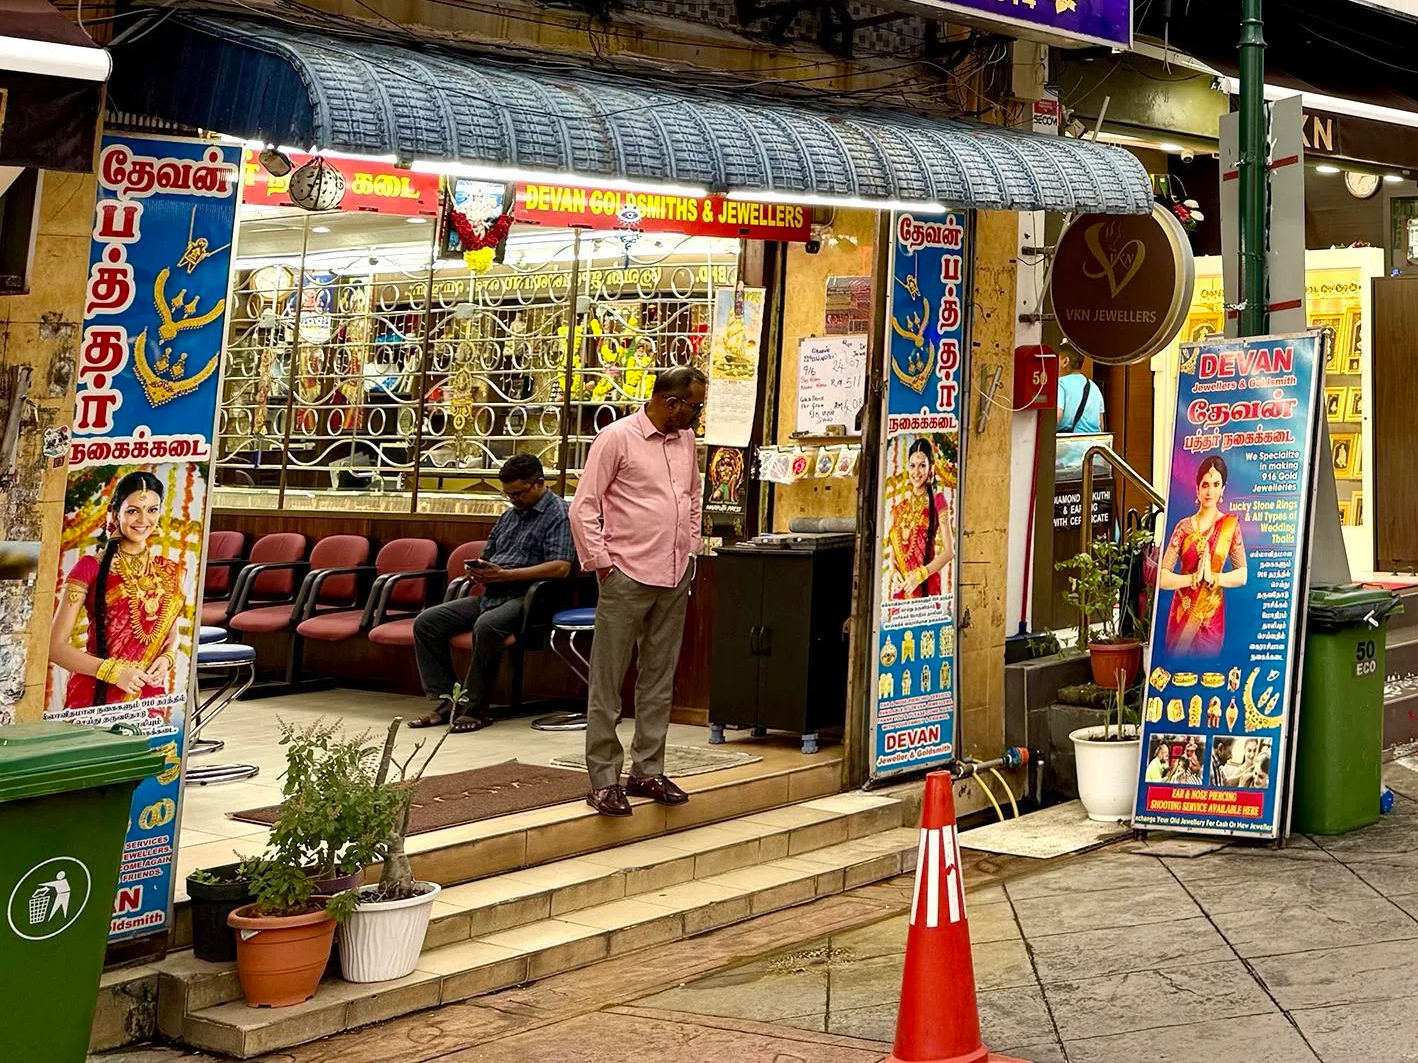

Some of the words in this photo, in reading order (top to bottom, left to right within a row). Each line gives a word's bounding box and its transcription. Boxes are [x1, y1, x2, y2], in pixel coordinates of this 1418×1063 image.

[102, 147, 230, 195] தேவன்
[525, 184, 587, 215] DEVAN
[702, 200, 714, 223] &
[718, 200, 804, 228] JEWELLERS
[899, 214, 962, 248] தேவன்
[1066, 307, 1092, 324] VKN
[1094, 308, 1157, 324] JEWELLERS
[1199, 346, 1294, 379] DEVAN
[1192, 380, 1236, 394] Jewellers
[1238, 378, 1246, 390] &
[1248, 375, 1297, 390] Goldsmith
[1187, 389, 1297, 429] தேவன்
[888, 405, 957, 431] நகைக்கடை
[69, 425, 208, 465] நகைக்கடை
[1245, 451, 1257, 462] We
[1259, 449, 1300, 462] Specialize
[1259, 462, 1267, 471] in
[1268, 461, 1299, 473] making
[1261, 472, 1277, 482] 916
[1278, 471, 1298, 482] Gold
[1229, 502, 1252, 514] Lucky
[1253, 500, 1275, 511] Stone
[1276, 498, 1298, 511] Rings
[1252, 511, 1264, 522] All
[1260, 522, 1297, 535] Wedding
[1356, 640, 1376, 661] 50
[1356, 659, 1376, 676] ECO
[886, 726, 940, 751] DEVAN
[878, 752, 909, 767] Jeweller
[909, 749, 916, 759] &
[916, 744, 951, 758] Goldsmith
[1172, 789, 1184, 799] EAR
[1191, 790, 1208, 800] NOSE
[1209, 791, 1237, 803] PIERCING
[1150, 799, 1181, 811] SHOOTING
[1182, 801, 1207, 813] SERVICE
[1208, 803, 1241, 815] AVAILABLE
[1242, 805, 1260, 817] HERE
[1157, 816, 1170, 824] Your
[1170, 816, 1180, 825] Old
[1181, 818, 1205, 827] Jewellery
[1206, 818, 1215, 827] For
[1216, 819, 1229, 828] Cash
[126, 836, 169, 849] SERVICES
[145, 856, 173, 868] AGAIN
[122, 868, 163, 882] FRIENDS.
